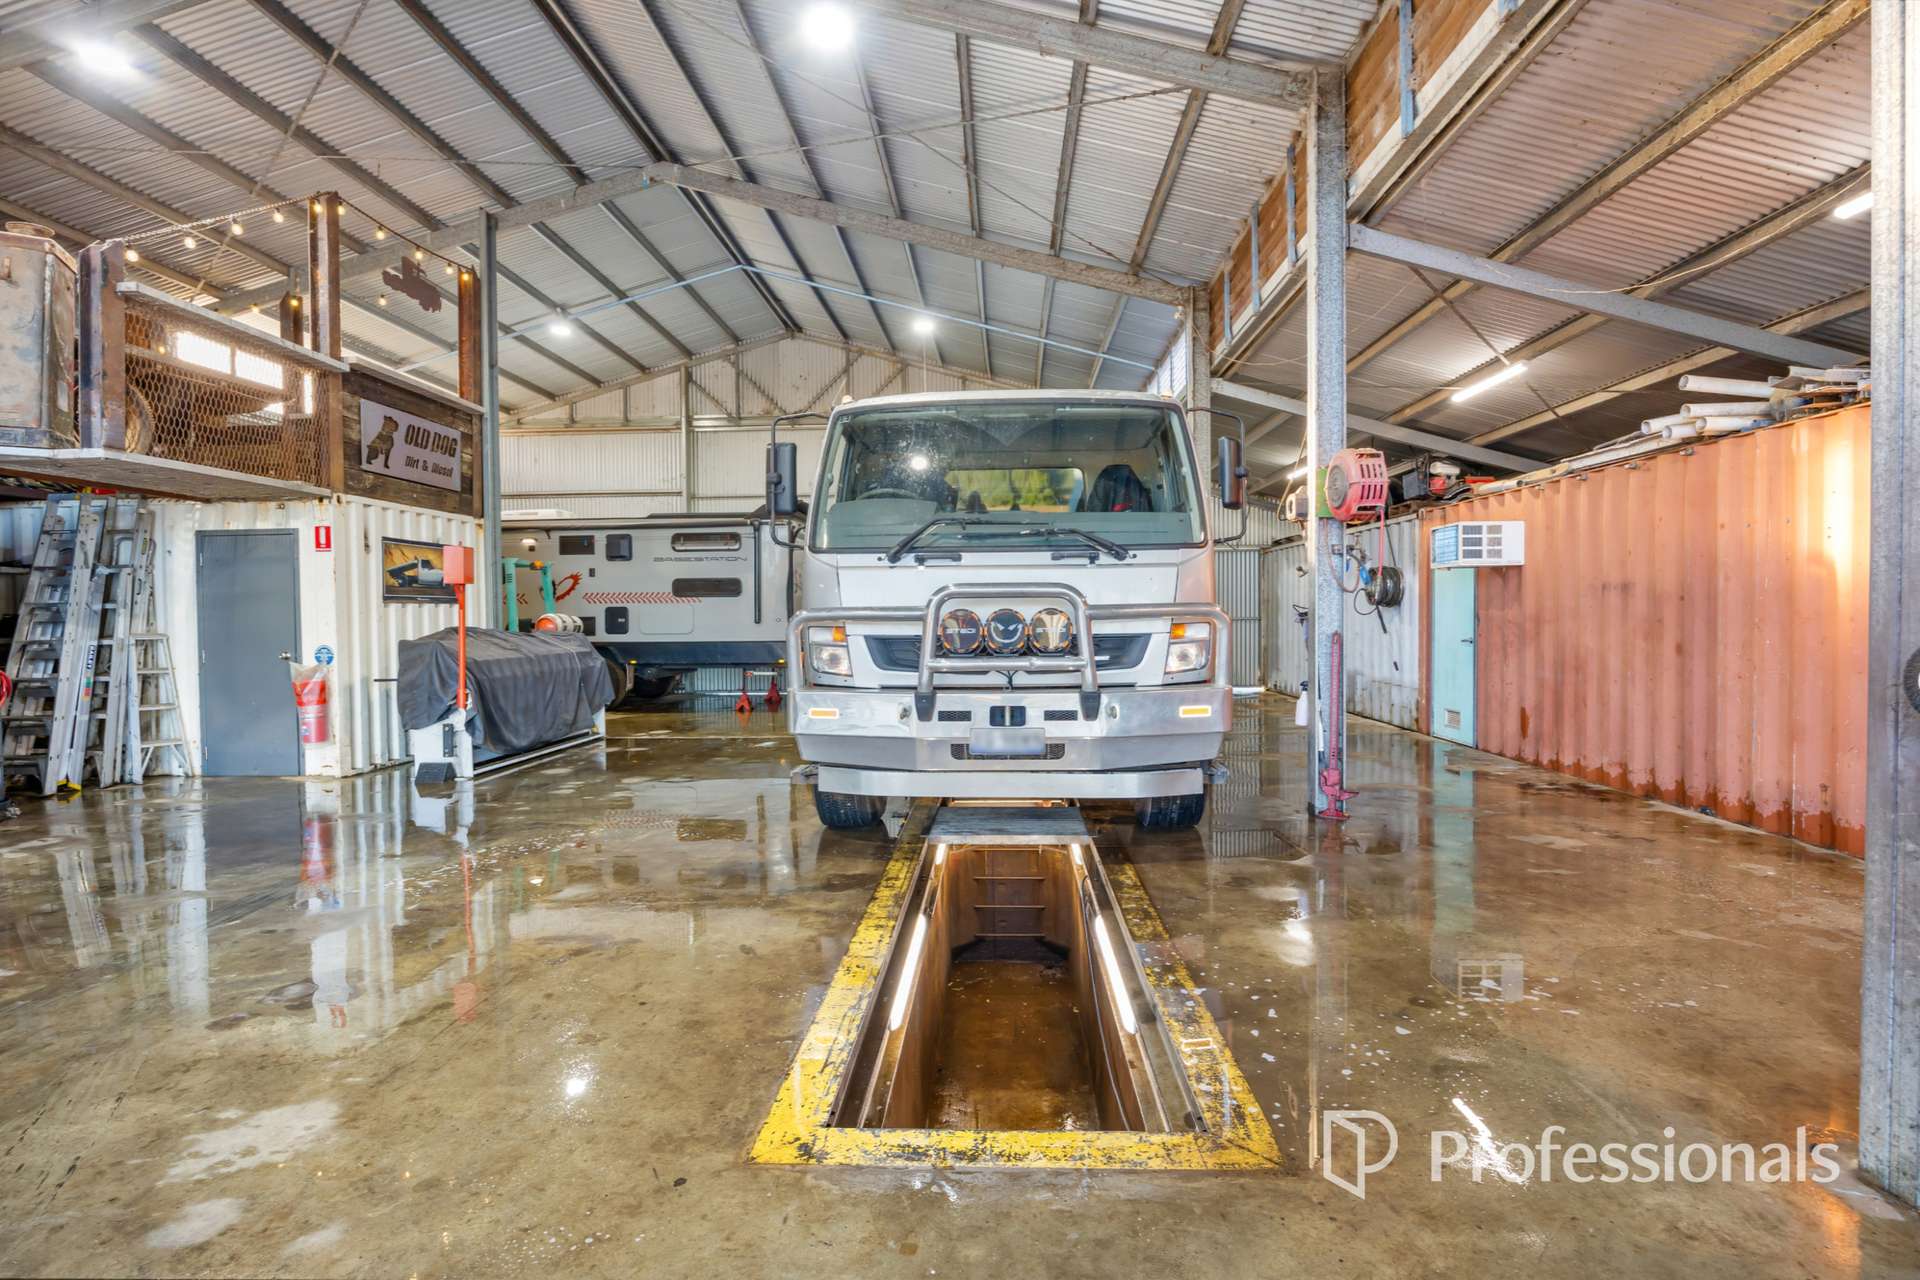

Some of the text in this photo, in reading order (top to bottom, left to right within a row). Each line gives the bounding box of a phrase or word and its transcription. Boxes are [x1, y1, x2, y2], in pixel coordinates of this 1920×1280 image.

[404, 424, 458, 458] OLD DOG
[405, 456, 419, 469] Dirt
[422, 459, 429, 472] &
